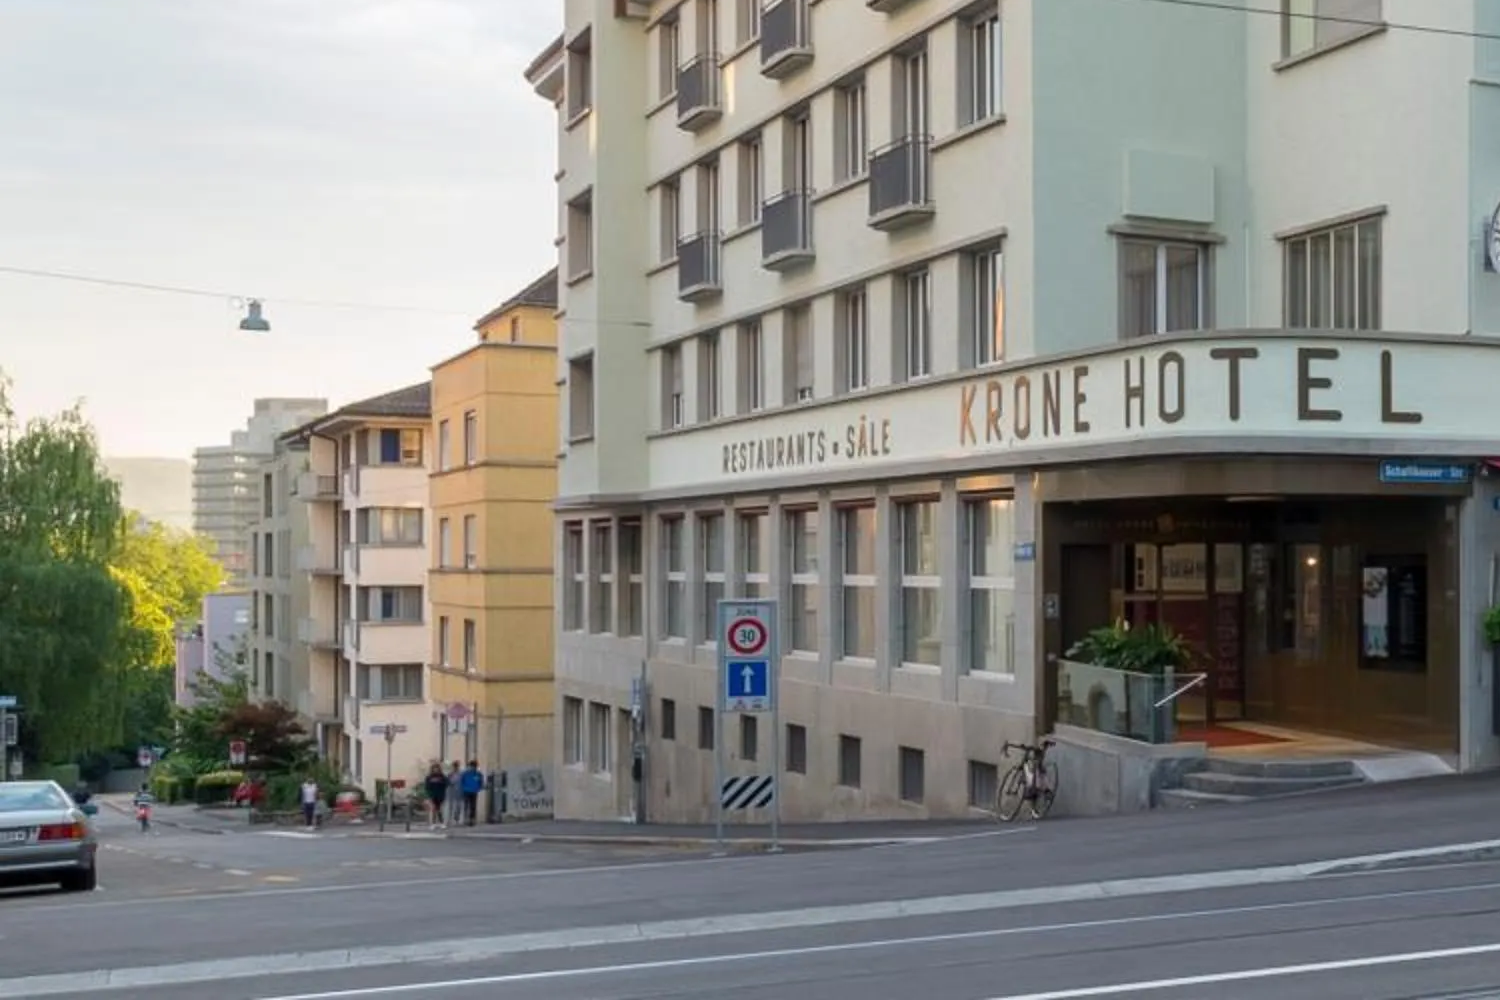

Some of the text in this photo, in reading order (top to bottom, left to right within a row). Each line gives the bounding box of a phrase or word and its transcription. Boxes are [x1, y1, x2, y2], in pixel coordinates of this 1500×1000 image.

[959, 365, 1091, 447] KRONE
[1124, 346, 1423, 428] HOTEL
[722, 430, 826, 474] RESTAURANTS
[738, 628, 756, 643] 30
